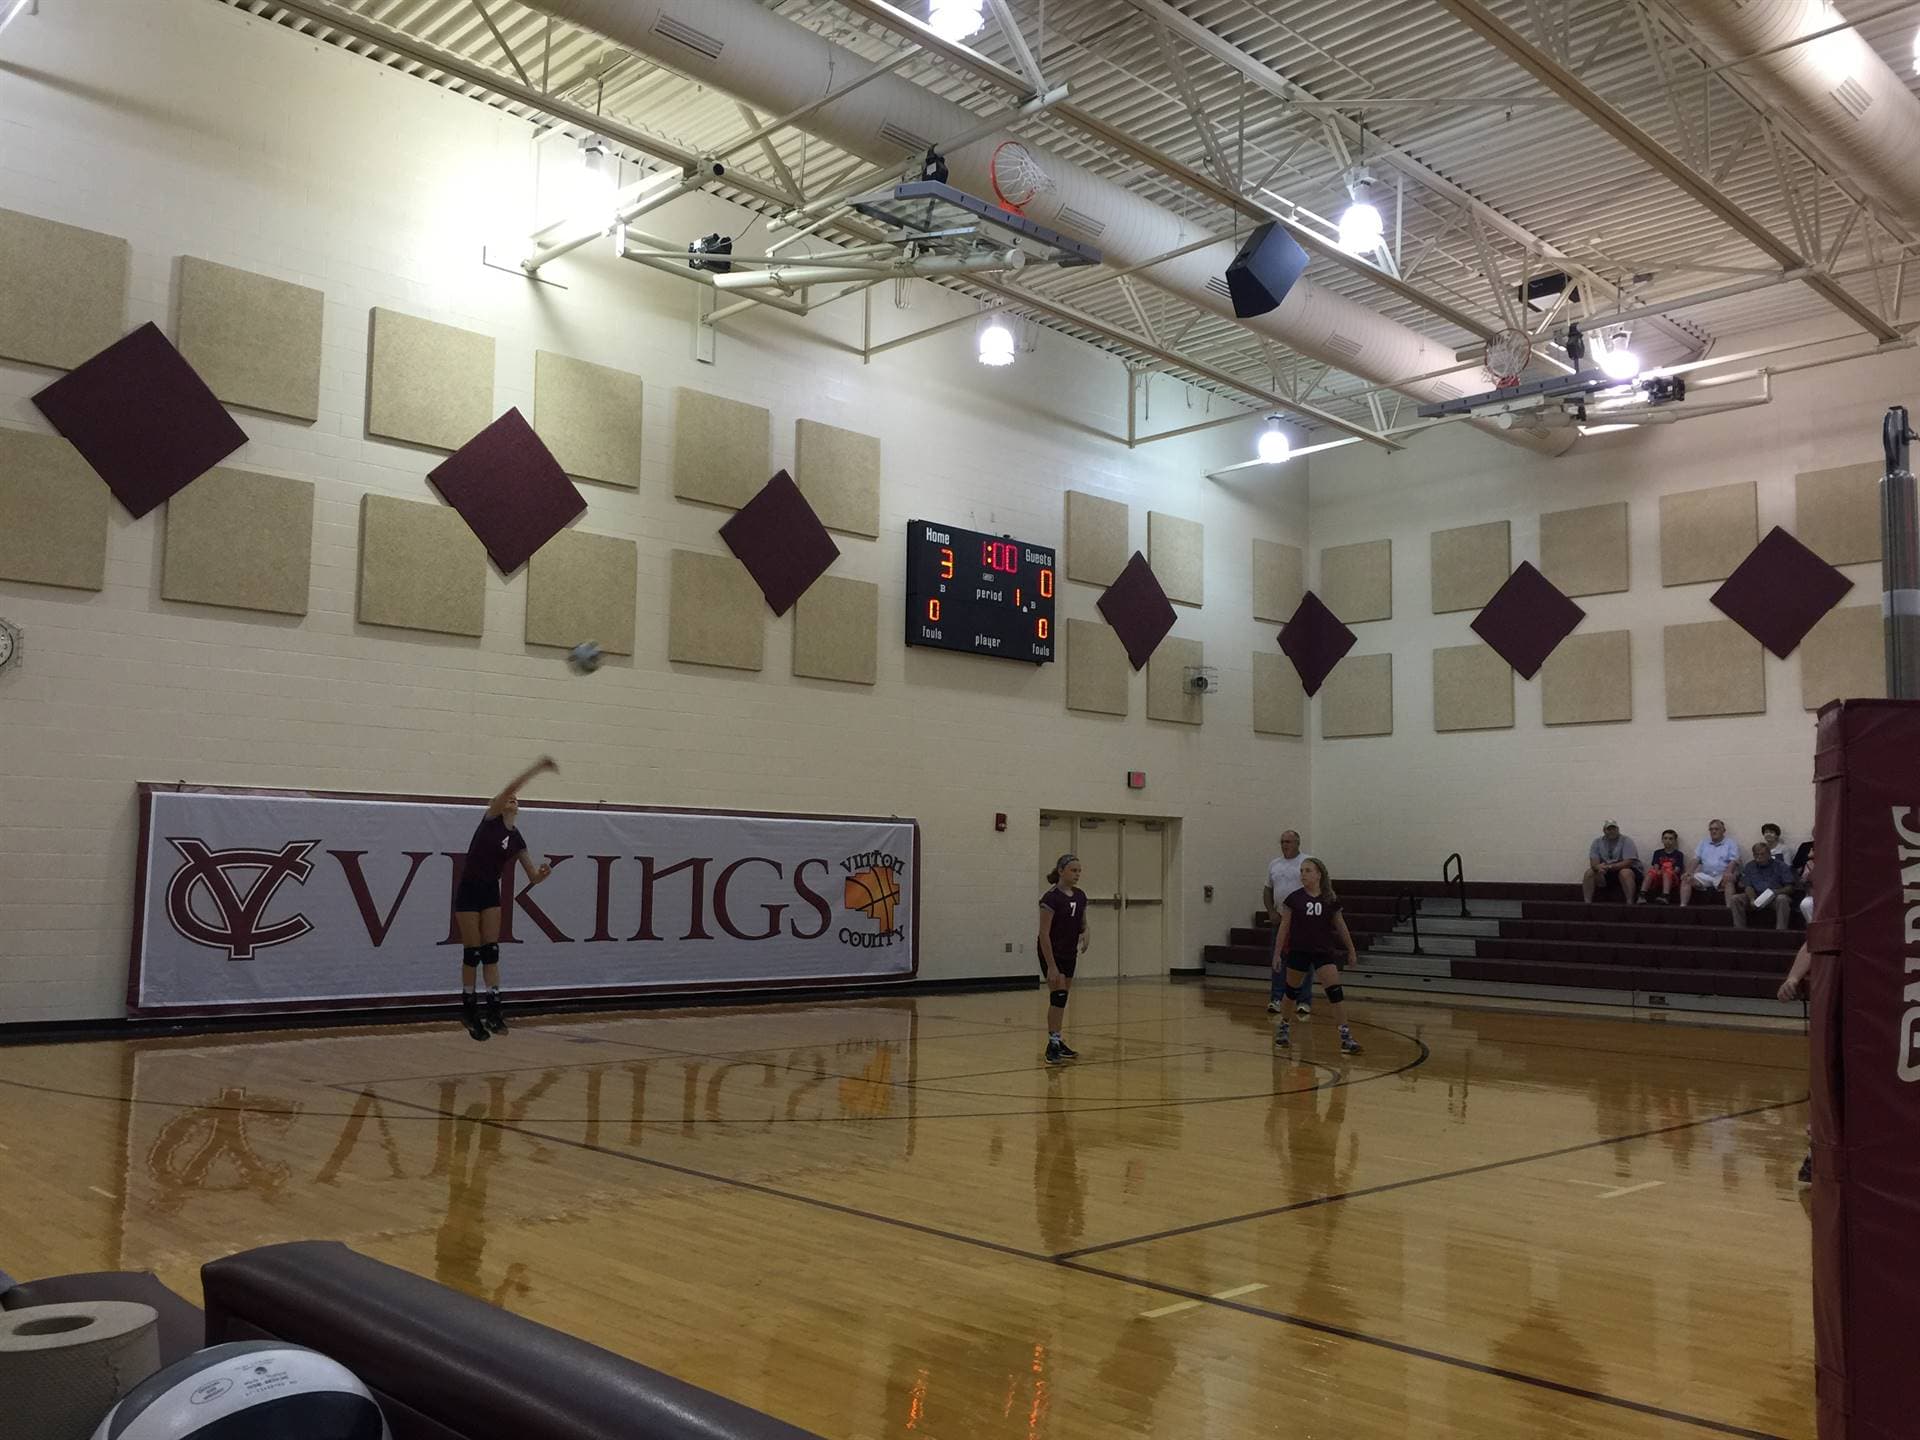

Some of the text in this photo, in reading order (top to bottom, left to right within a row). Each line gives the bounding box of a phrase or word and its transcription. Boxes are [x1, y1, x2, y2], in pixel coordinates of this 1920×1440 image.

[926, 527, 950, 545] Home
[941, 548, 954, 579] 3
[1025, 548, 1052, 566] Guests
[1041, 569, 1053, 598] 0
[976, 588, 1003, 602] period
[929, 599, 940, 621] 0
[922, 625, 942, 640] fouls
[1039, 618, 1048, 639] 0
[975, 634, 1001, 649] player
[1032, 643, 1050, 657] fouls
[840, 849, 906, 876] VINTON
[326, 849, 831, 947] VIKINGS
[1070, 901, 1076, 916] 7
[1306, 902, 1322, 916] 20
[838, 924, 905, 948] COUNTY
